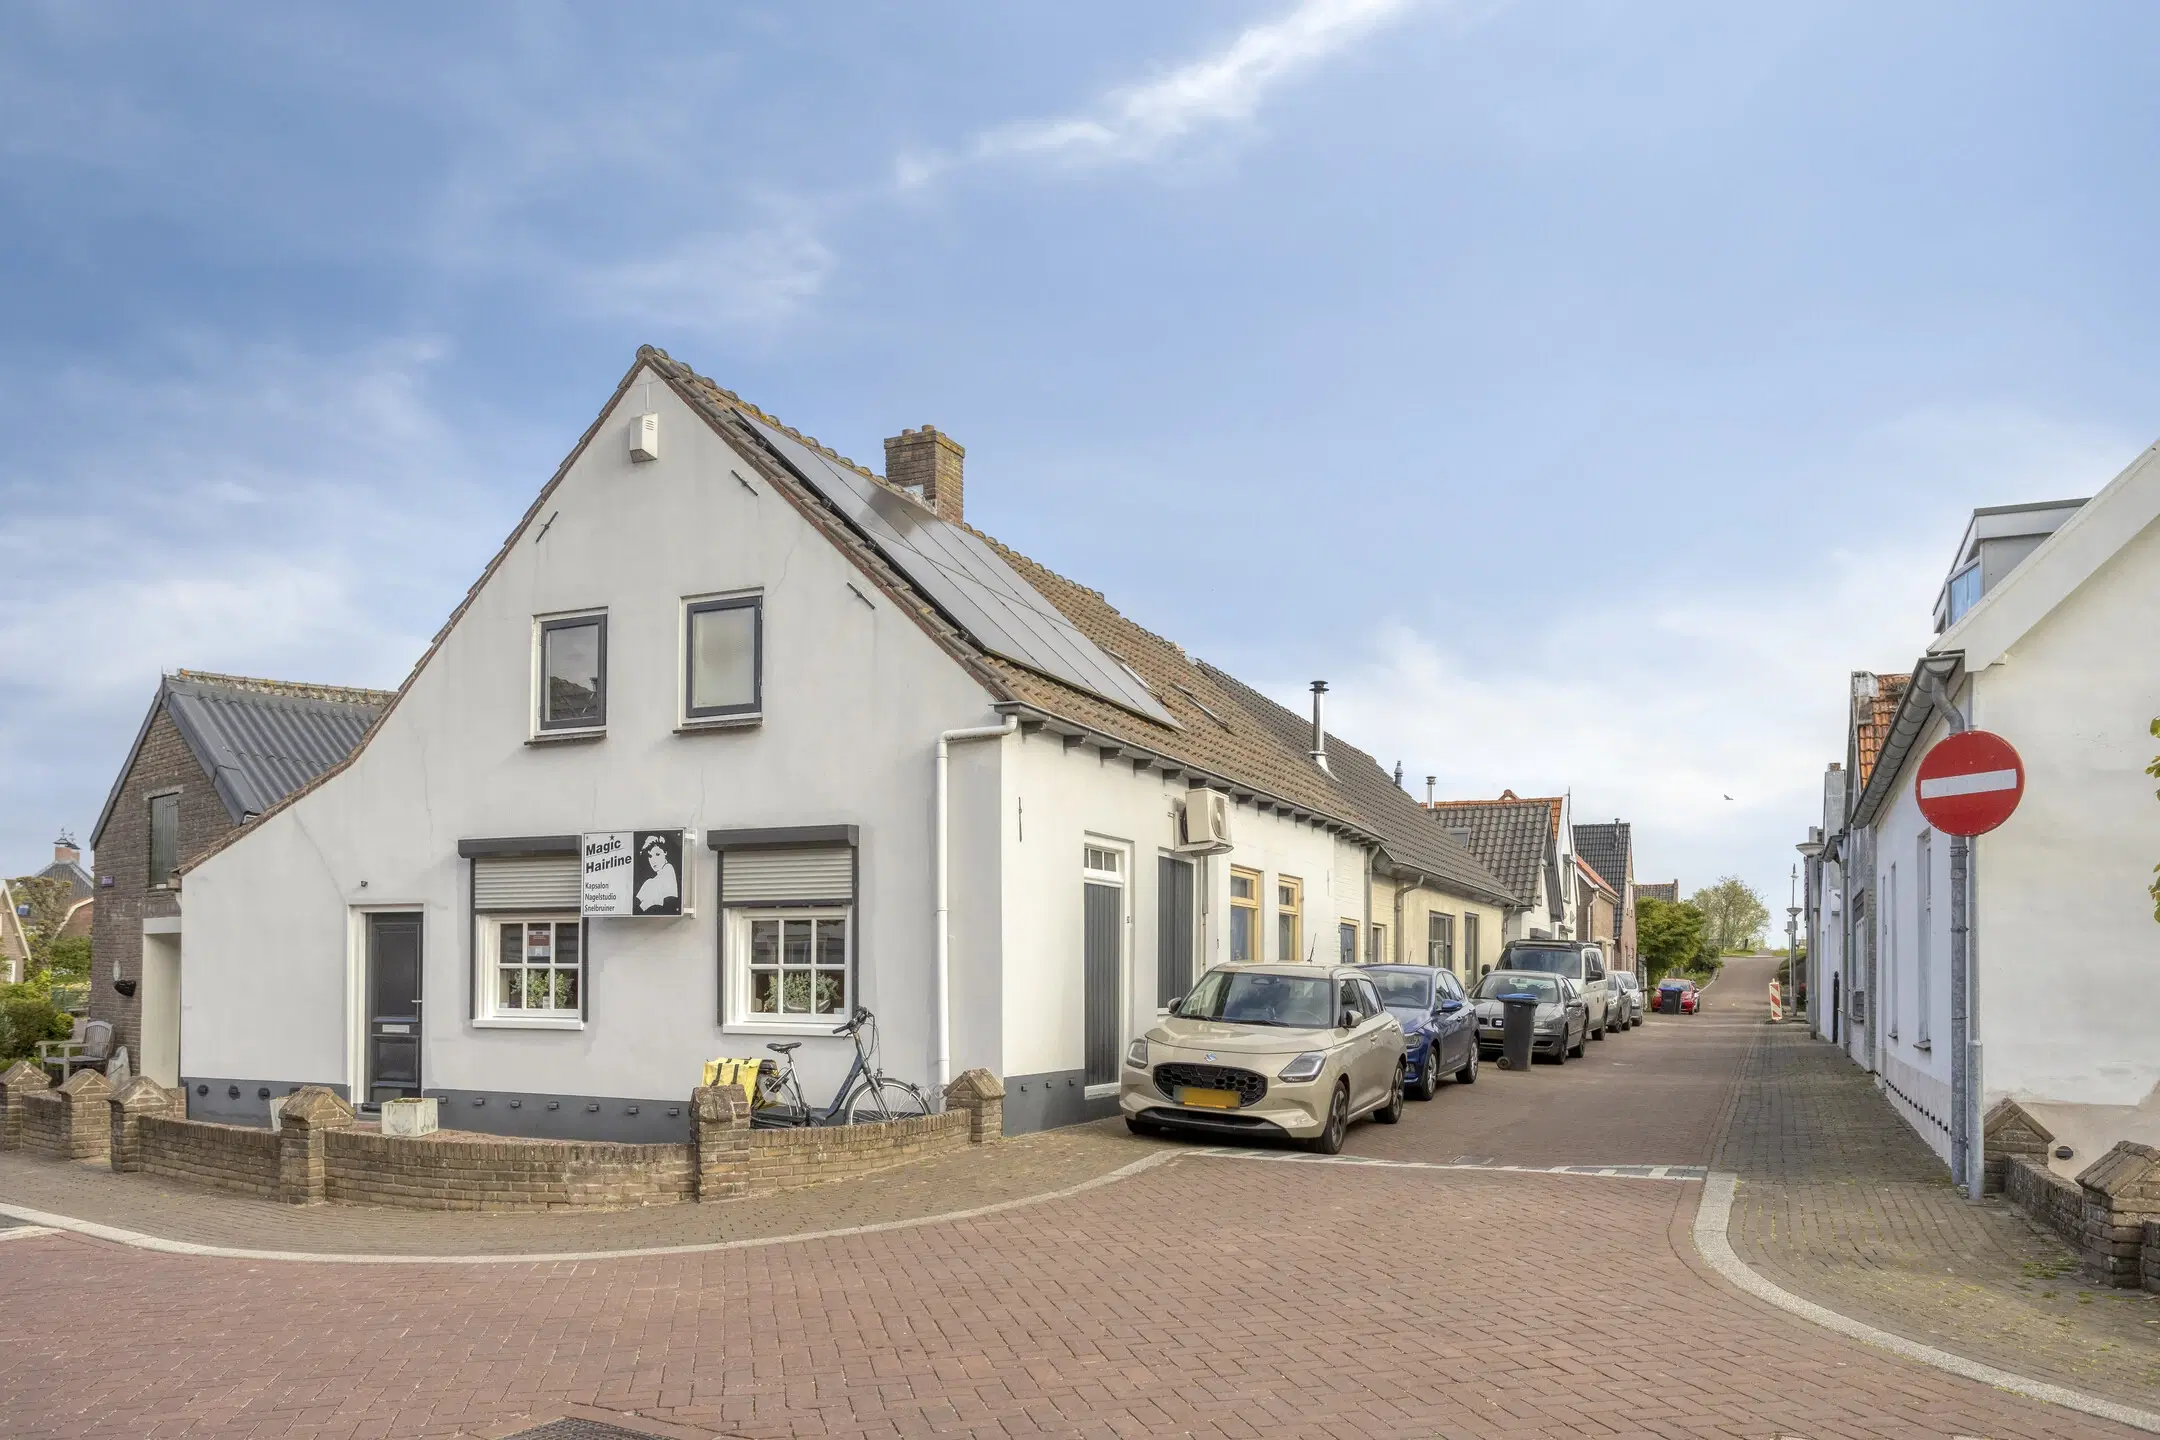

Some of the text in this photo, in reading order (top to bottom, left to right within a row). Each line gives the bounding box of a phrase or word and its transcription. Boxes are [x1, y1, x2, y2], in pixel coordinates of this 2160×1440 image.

[586, 840, 621, 856] Magic
[586, 855, 632, 873] Hairline
[585, 882, 609, 891] Kapsalon
[585, 893, 616, 902] Nagelstudio
[584, 904, 615, 912] Snelbruiner
